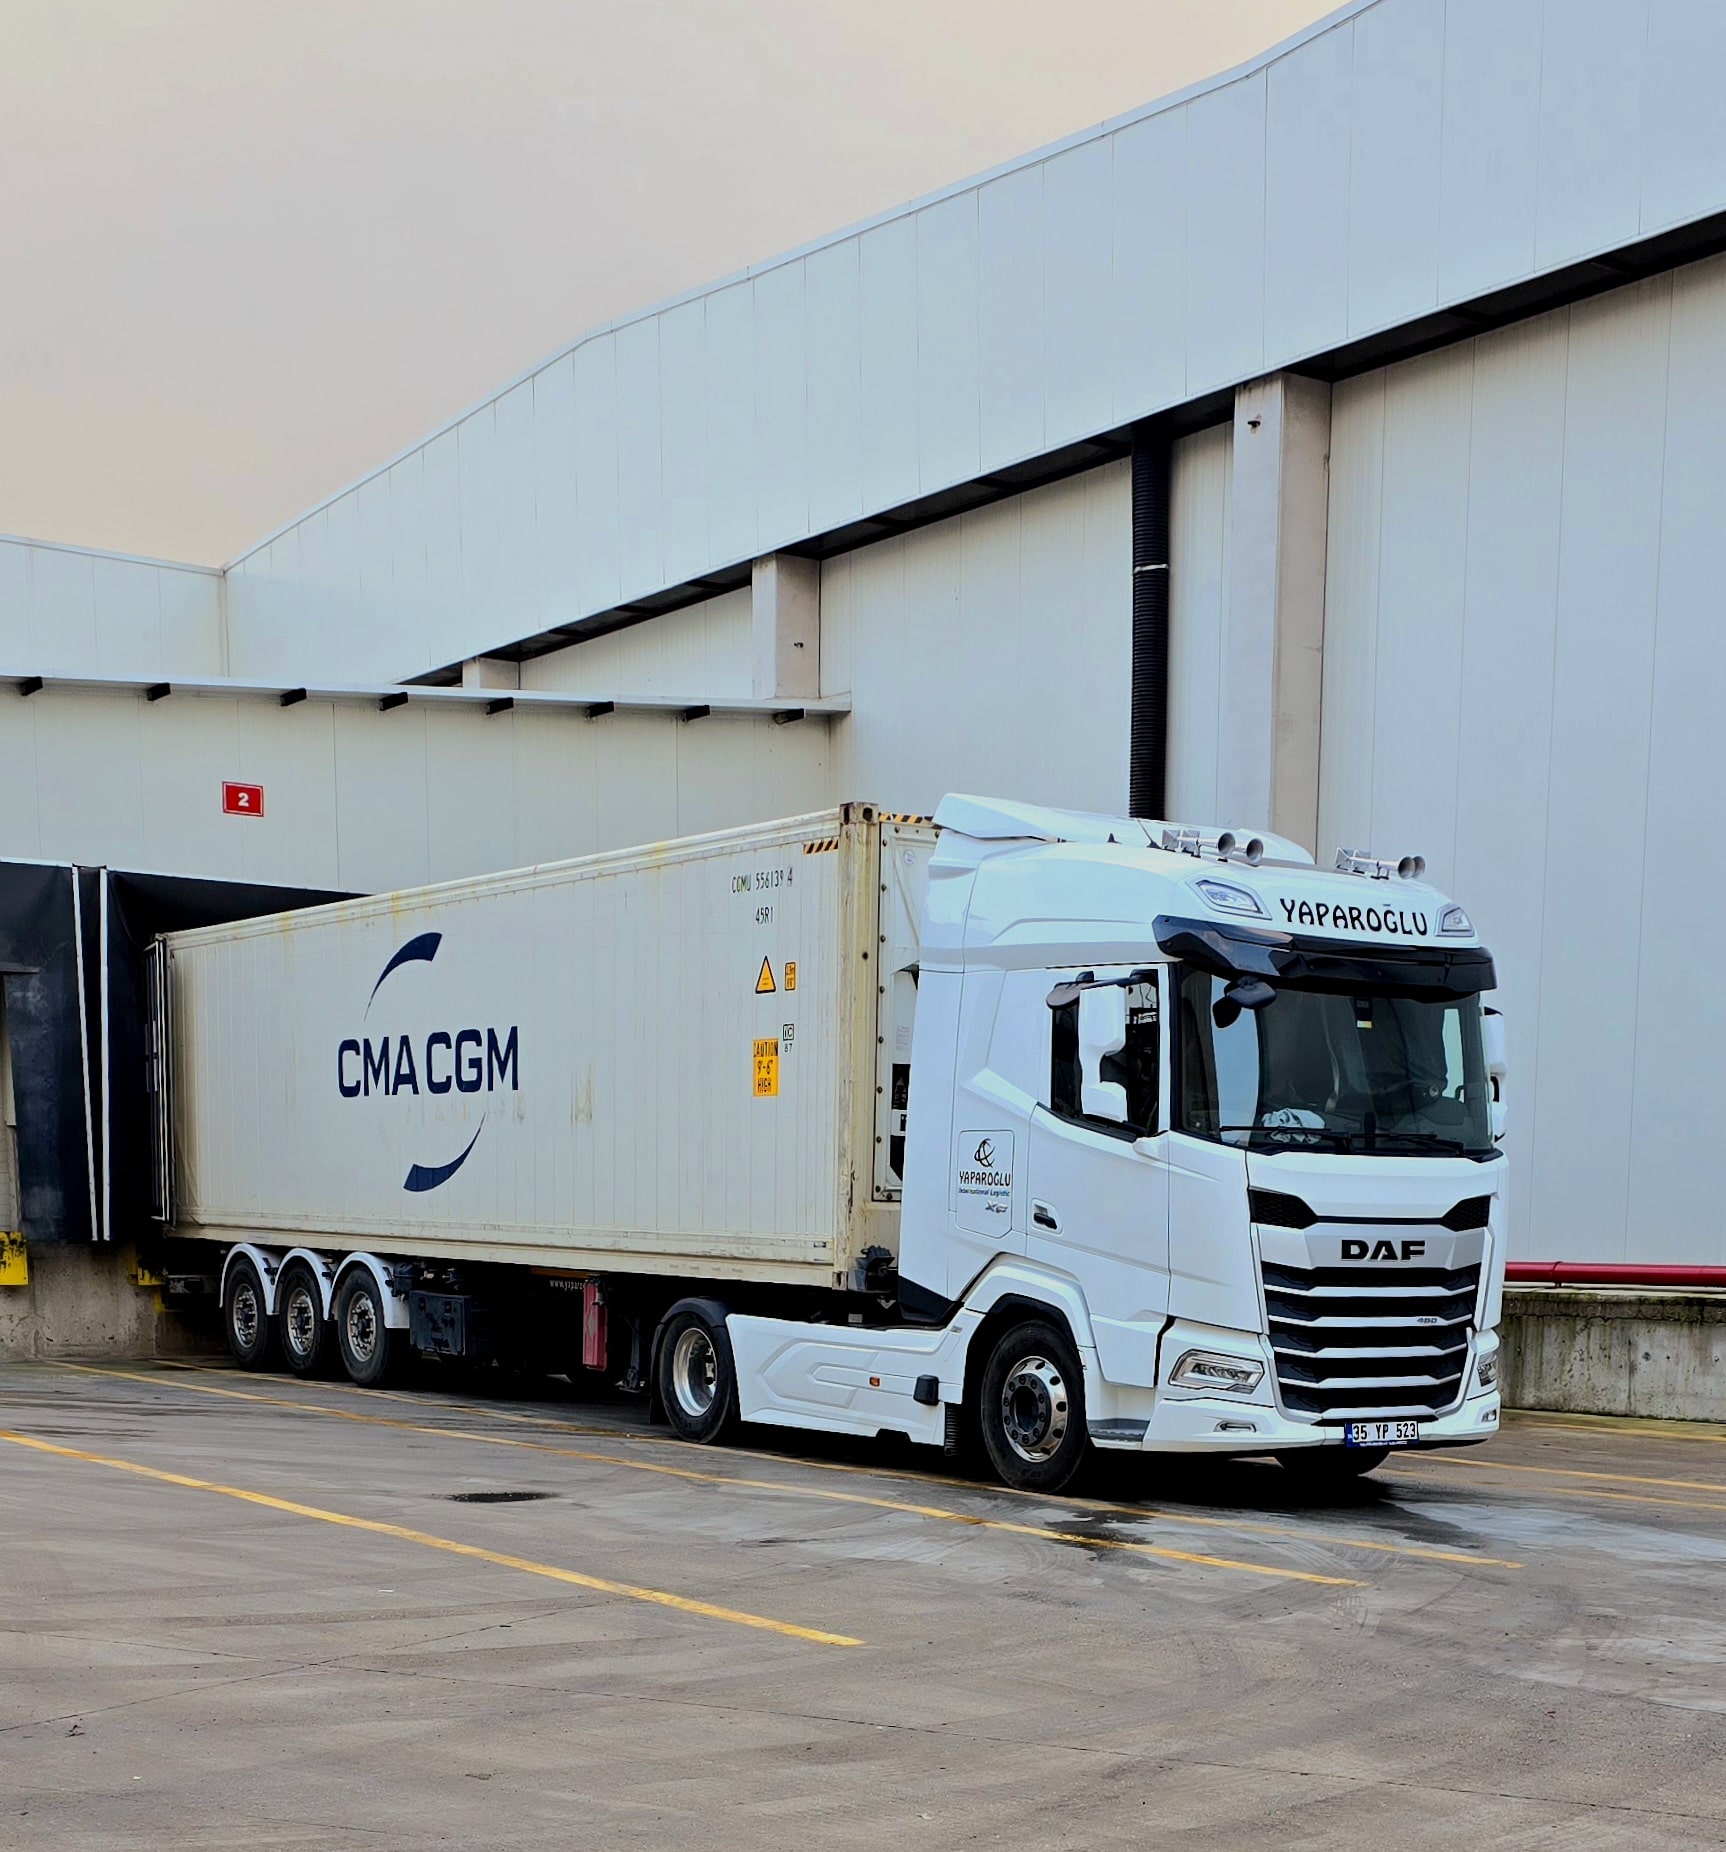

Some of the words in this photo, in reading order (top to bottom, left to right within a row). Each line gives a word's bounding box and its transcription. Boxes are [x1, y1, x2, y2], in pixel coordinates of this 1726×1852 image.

[238, 792, 249, 807] 2
[756, 869, 784, 890] 556139
[787, 867, 793, 887] 4
[756, 906, 773, 925] 45R1
[1279, 898, 1428, 936] YAPAROĞLU
[338, 1035, 420, 1098] CMA
[426, 1026, 519, 1095] CGM
[1341, 1239, 1426, 1261] DAF
[1353, 1424, 1367, 1441] 35
[1375, 1424, 1389, 1440] YP
[1396, 1422, 1416, 1439] 523
